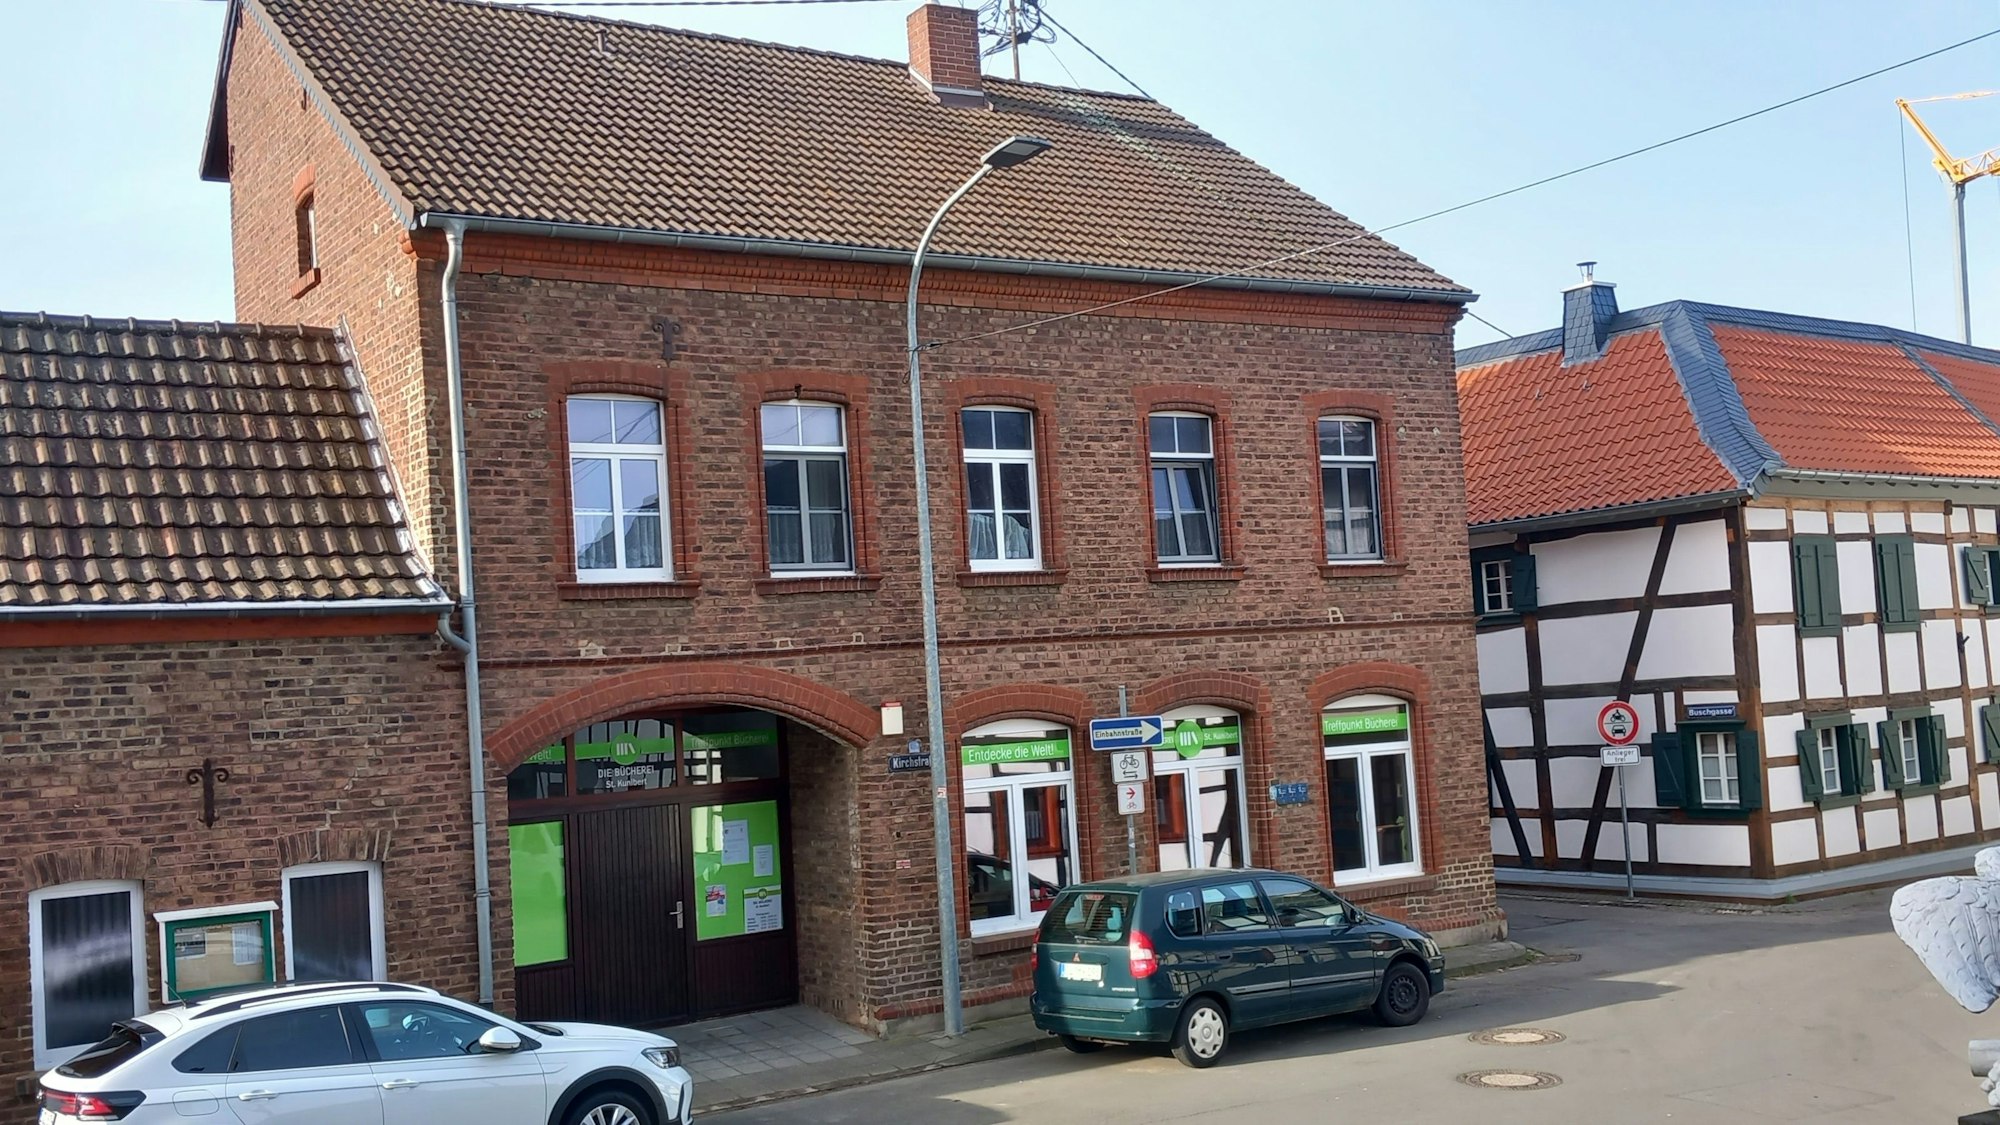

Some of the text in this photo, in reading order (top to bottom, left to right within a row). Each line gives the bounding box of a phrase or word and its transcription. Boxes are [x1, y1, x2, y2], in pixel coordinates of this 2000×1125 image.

[1688, 708, 1732, 718] Buschgasse
[1324, 716, 1398, 733] Treffpunkt Bücherei
[1095, 729, 1143, 738] Einbahnstraße
[968, 743, 1054, 762] Entdecke die Welt!
[892, 756, 931, 768] Kirchstra
[597, 765, 655, 778] DIE BÜCHEREI
[605, 778, 648, 789] St. Kunibert
